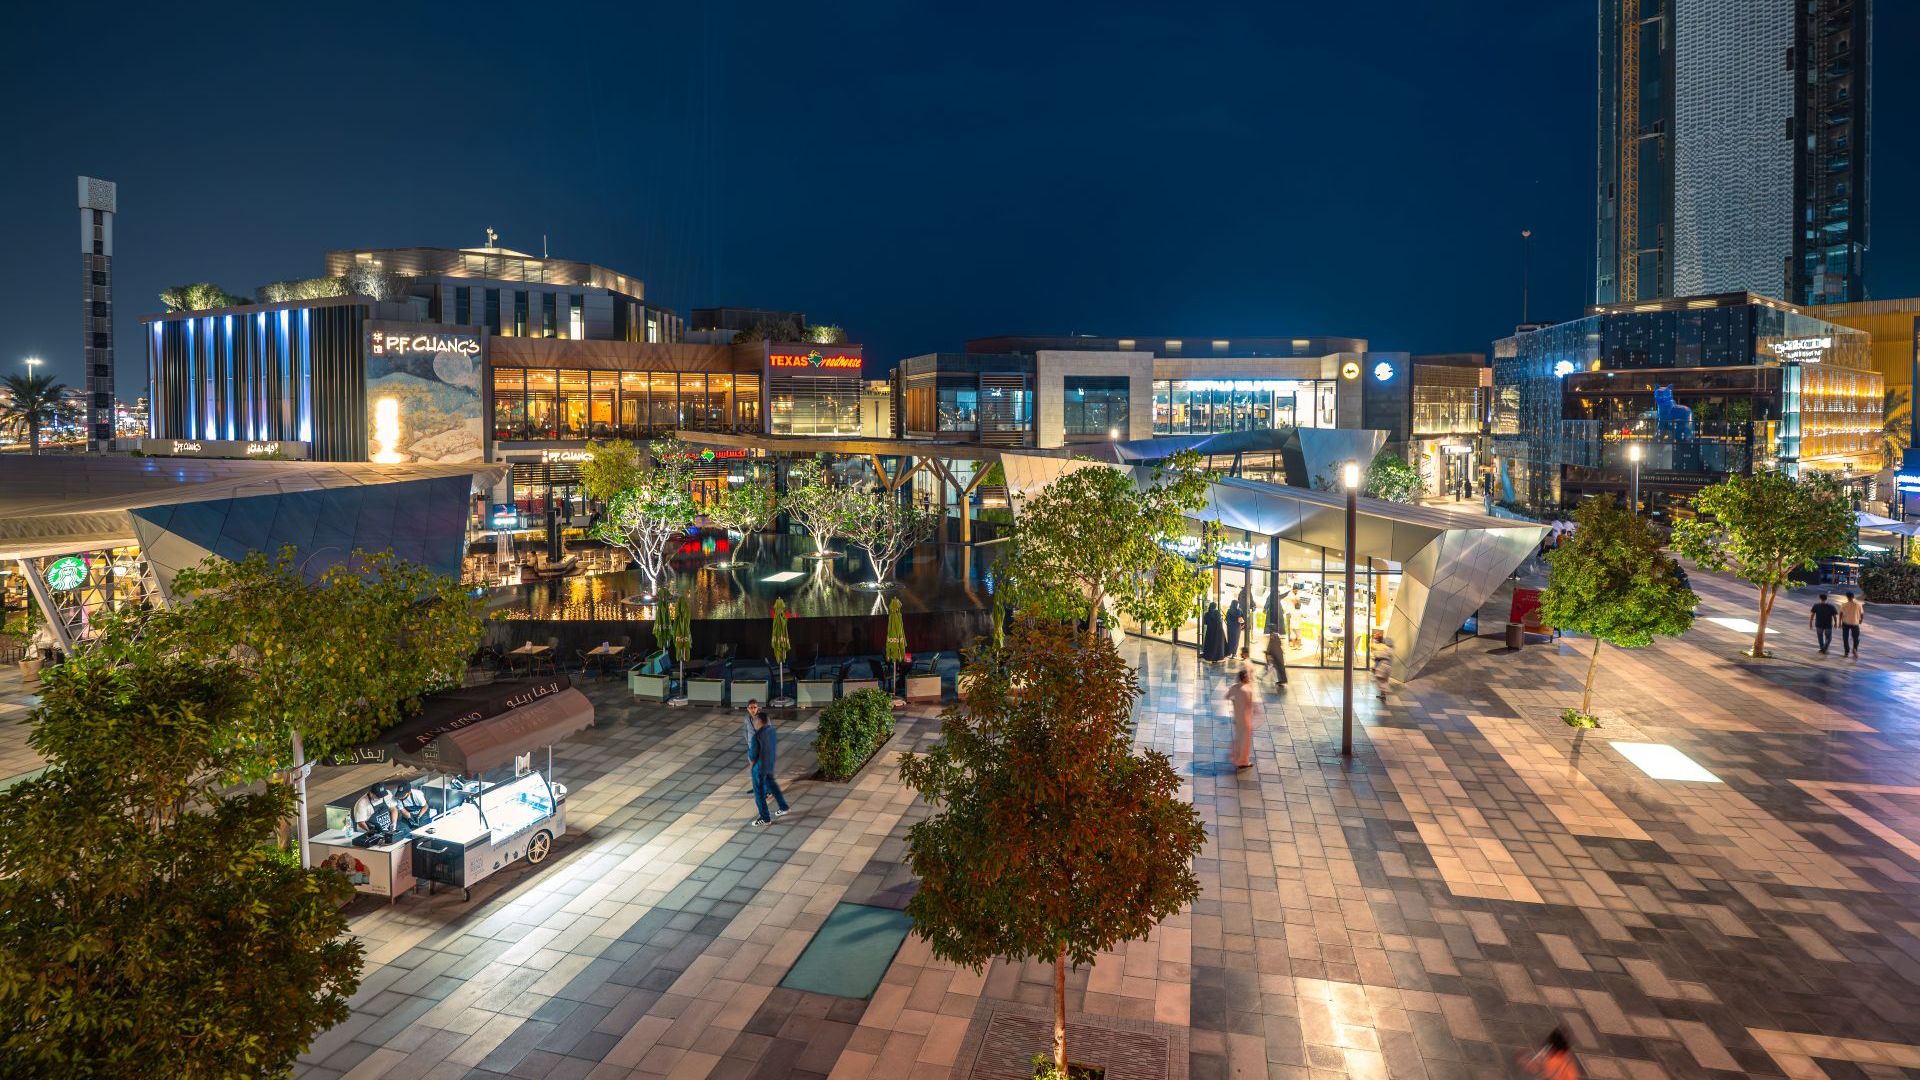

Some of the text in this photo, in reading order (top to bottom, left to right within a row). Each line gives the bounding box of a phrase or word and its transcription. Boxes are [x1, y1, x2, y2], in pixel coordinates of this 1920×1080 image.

[386, 336, 479, 356] P.F. CHANG'S
[769, 355, 862, 368] TEXAS roadhouse
